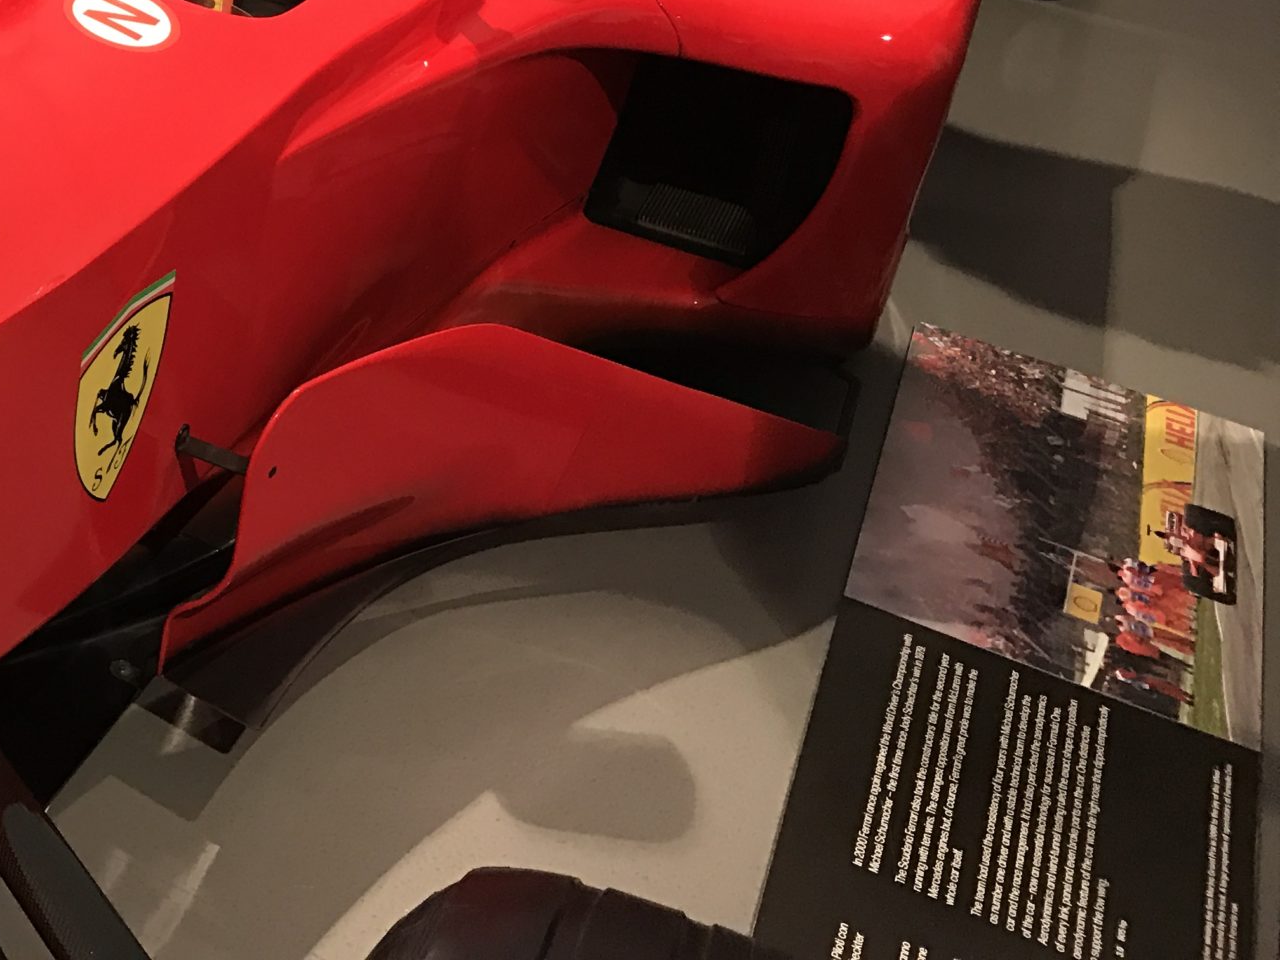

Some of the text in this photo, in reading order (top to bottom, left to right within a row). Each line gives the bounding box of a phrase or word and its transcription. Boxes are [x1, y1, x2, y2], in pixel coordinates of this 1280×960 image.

[91, 467, 103, 491] S
[941, 653, 949, 668] year
[912, 666, 921, 677] win
[936, 666, 947, 691] second
[968, 669, 978, 680] the
[932, 690, 942, 702] the
[966, 680, 976, 698] make
[930, 701, 940, 711] for
[963, 705, 971, 718] was
[900, 714, 912, 731] Jody
[1034, 695, 1047, 740] aerodynamics
[959, 718, 969, 737] pride
[1047, 721, 1059, 749] Formula
[897, 731, 907, 749] since
[956, 735, 966, 755] great
[1031, 739, 1041, 751] the
[852, 633, 912, 866] In 2000 Ferrari once again regained the World Driver's Championship with
[892, 749, 903, 765] time
[1048, 748, 1055, 756] in
[888, 764, 900, 779] first
[917, 767, 927, 779] the
[1027, 750, 1039, 786] perfected
[1044, 755, 1055, 784] success
[1076, 758, 1087, 773] One
[886, 779, 897, 791] the
[913, 662, 963, 892] running with ten wins. The strongest opposition was from McLaren with
[914, 779, 924, 795] took
[970, 670, 1019, 916] The team had used the consistency four years with Michael Schumacher
[1024, 784, 1034, 800] also
[1040, 783, 1051, 795] for
[1073, 786, 1083, 798] the
[911, 795, 921, 811] also
[991, 695, 1031, 914] number one driver and with stable technical team develop the
[1021, 798, 1032, 814] had
[875, 797, 893, 843] Schumacher
[904, 810, 918, 836] Ferrari
[1036, 795, 1051, 834] technology
[1038, 699, 1077, 945] Aerodynamics and wind-tunnel testing ruled the exact shape and position
[1071, 808, 1081, 829] parts
[940, 817, 952, 831] but,
[1073, 705, 1110, 959] aerodynamic feature of the car was the high nose that dipped emphatically
[937, 831, 949, 860] engines
[1067, 828, 1078, 850] brake
[868, 842, 883, 873] Michael
[898, 835, 914, 869] Scuderia
[1033, 832, 1044, 867] essential
[1067, 849, 1076, 868] even
[894, 869, 907, 884] The
[928, 860, 943, 899] Mercedes
[945, 848, 963, 905] whole car itself.
[1013, 869, 1022, 888] race
[1064, 866, 1074, 883] and
[1009, 887, 1020, 901] the
[1029, 877, 1038, 895] now
[1062, 882, 1072, 906] panel
[1008, 899, 1018, 917] and
[1026, 900, 1035, 915] car
[1058, 906, 1070, 920] link,
[1094, 897, 1105, 912] low
[1006, 916, 1015, 931] car
[1022, 915, 1033, 928] the
[1092, 911, 1103, 925] the
[1058, 920, 1069, 943] every
[1091, 924, 1102, 957] support
[831, 922, 848, 960] Piloti con
[1054, 941, 1065, 952] of
